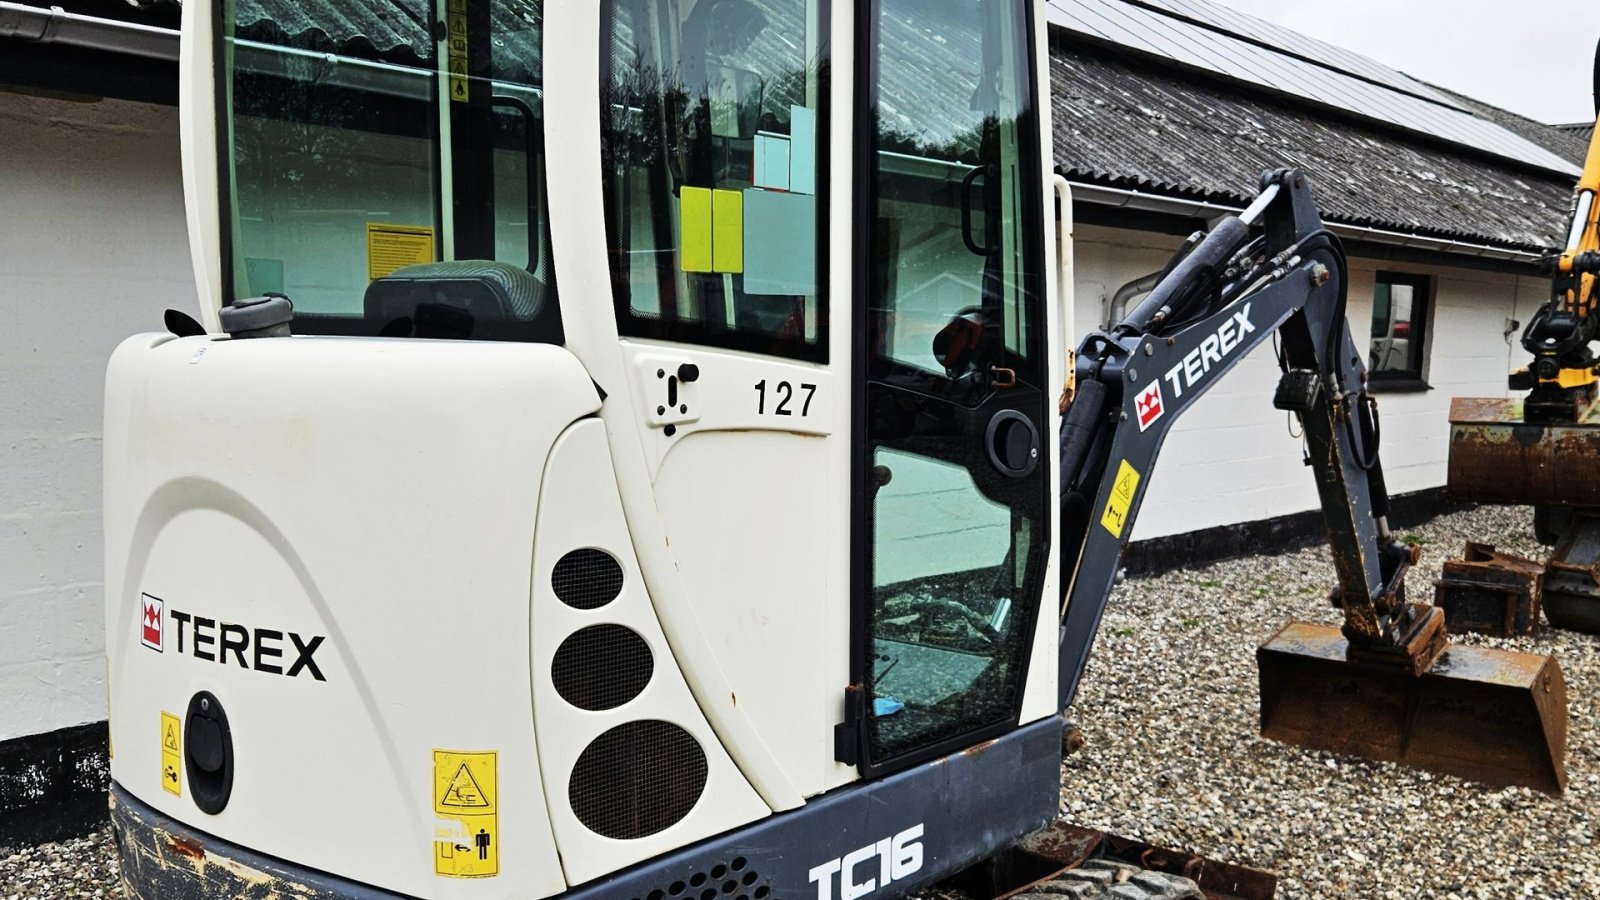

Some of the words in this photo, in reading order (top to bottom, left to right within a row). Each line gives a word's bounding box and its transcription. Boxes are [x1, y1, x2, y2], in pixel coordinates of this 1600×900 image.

[1164, 302, 1256, 398] TEREX
[754, 379, 817, 417] 127
[170, 609, 327, 682] TEREX
[808, 823, 924, 900] TC16
